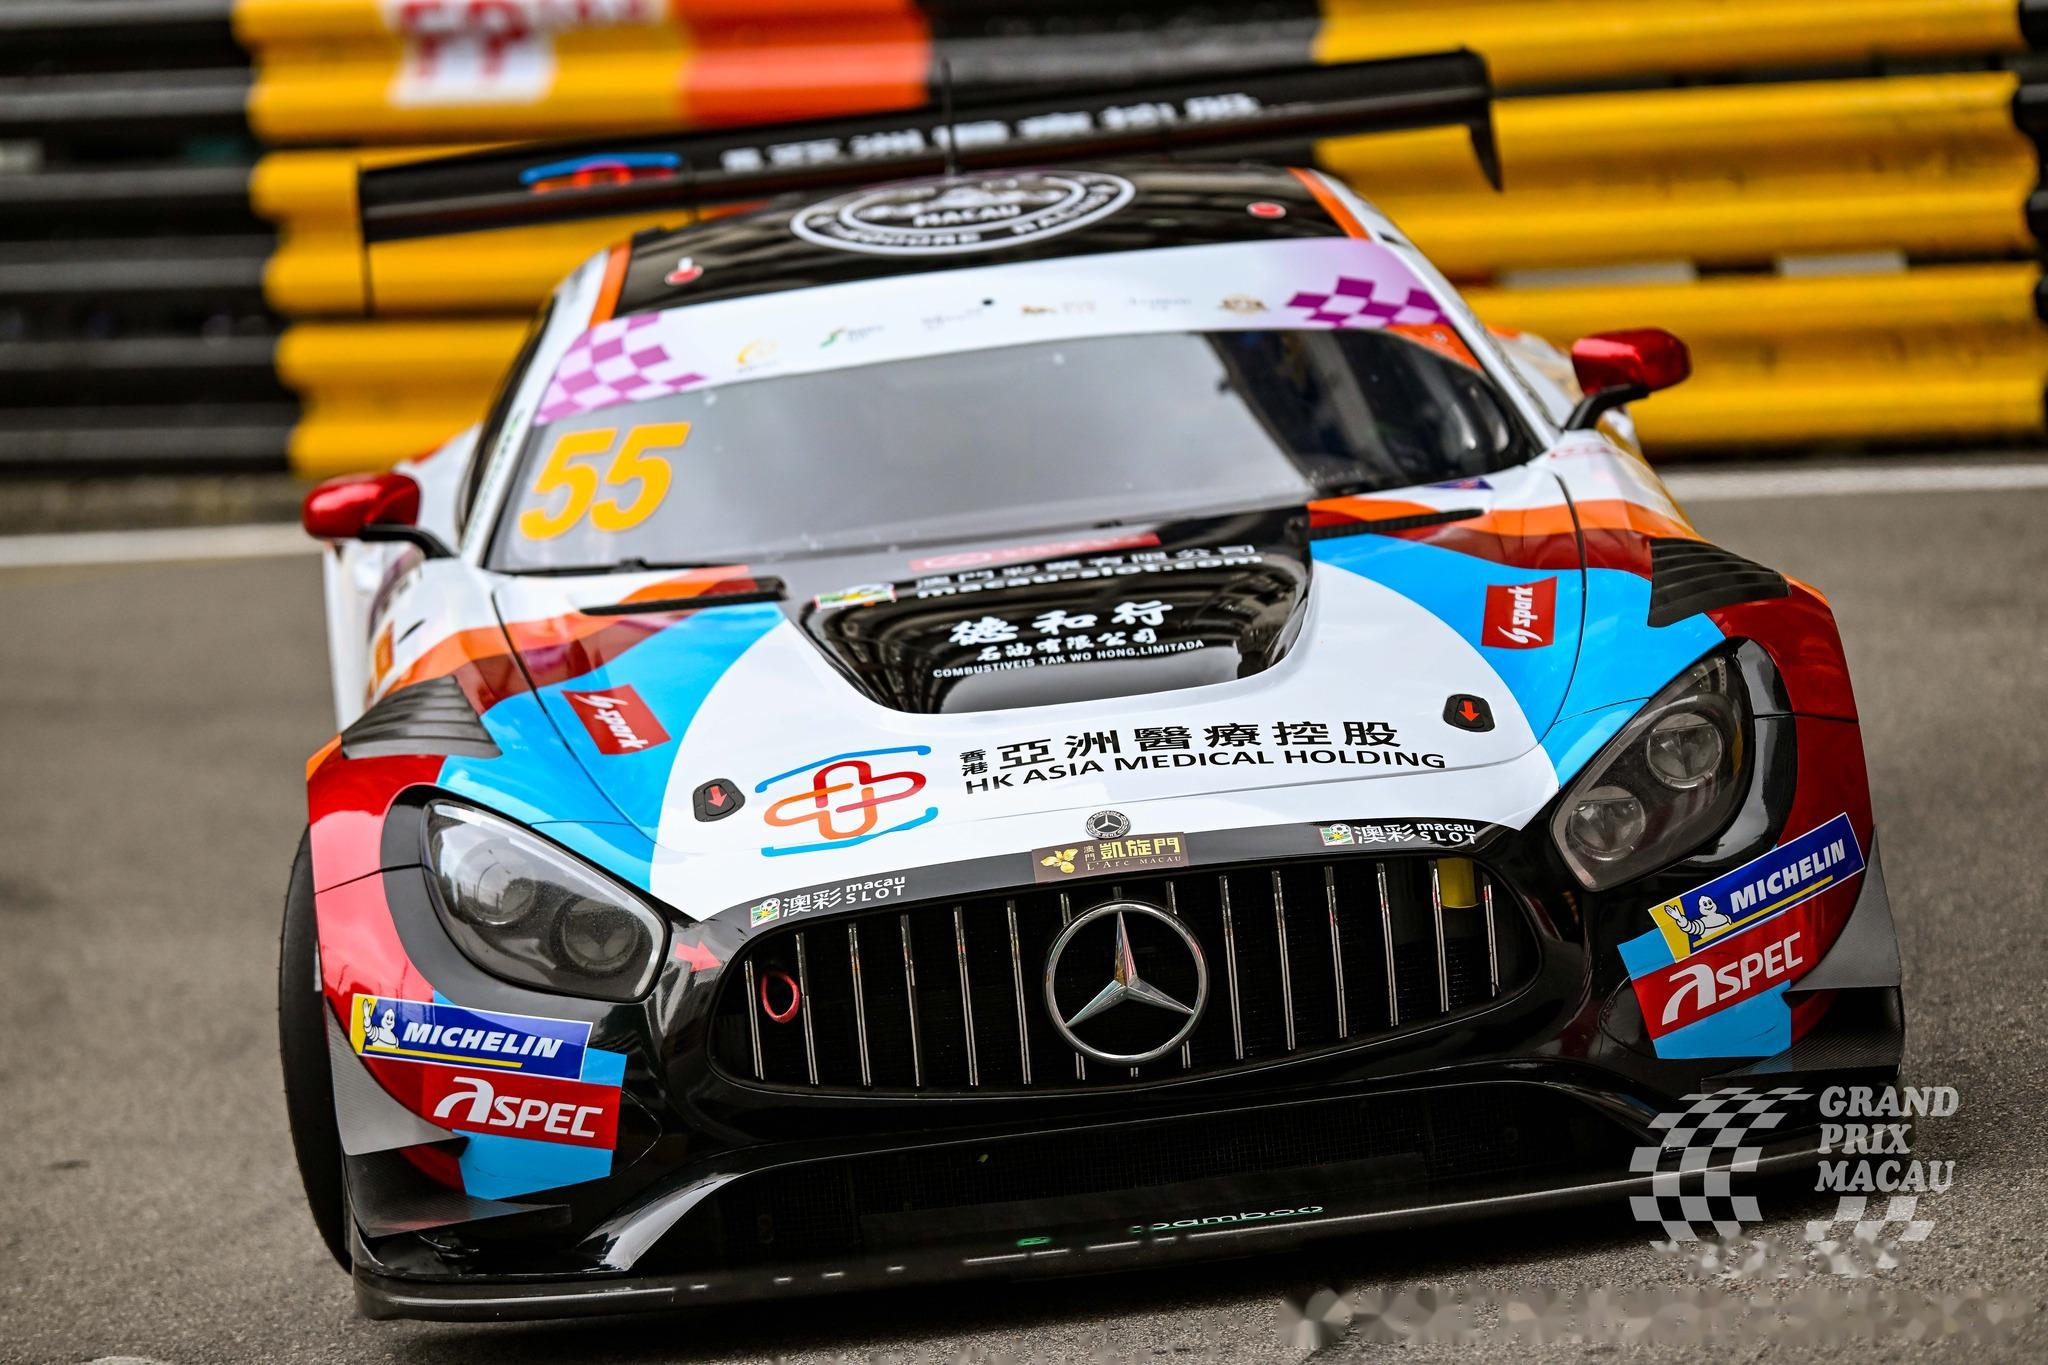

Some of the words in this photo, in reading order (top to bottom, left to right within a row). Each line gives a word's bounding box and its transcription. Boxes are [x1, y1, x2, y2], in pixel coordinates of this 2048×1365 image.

[518, 421, 692, 542] 55
[977, 628, 1158, 662] 石油有限公司
[932, 658, 1036, 679] COMBUSTIVEIS
[1040, 654, 1066, 665] TAK
[1071, 652, 1092, 663] WO
[997, 721, 1401, 770] 亞洲醫療控股
[960, 749, 988, 777] 香港
[966, 773, 1014, 795] HK
[1023, 761, 1104, 785] ASIA
[1114, 751, 1274, 771] MEDICAL
[1285, 750, 1446, 769] HOLDING
[1354, 823, 1416, 845] 澳彩
[1416, 822, 1475, 833] macau
[1420, 831, 1477, 845] SLOT
[1099, 837, 1181, 860] 凱旋門
[846, 876, 906, 894] macau
[1730, 838, 1846, 914] MICHELIN
[782, 887, 842, 918] 澳彩
[845, 885, 905, 905] SLOT
[1661, 931, 1804, 1026] ASPEC
[402, 1022, 564, 1059] MICHELIN
[433, 1076, 604, 1138] ASPEC
